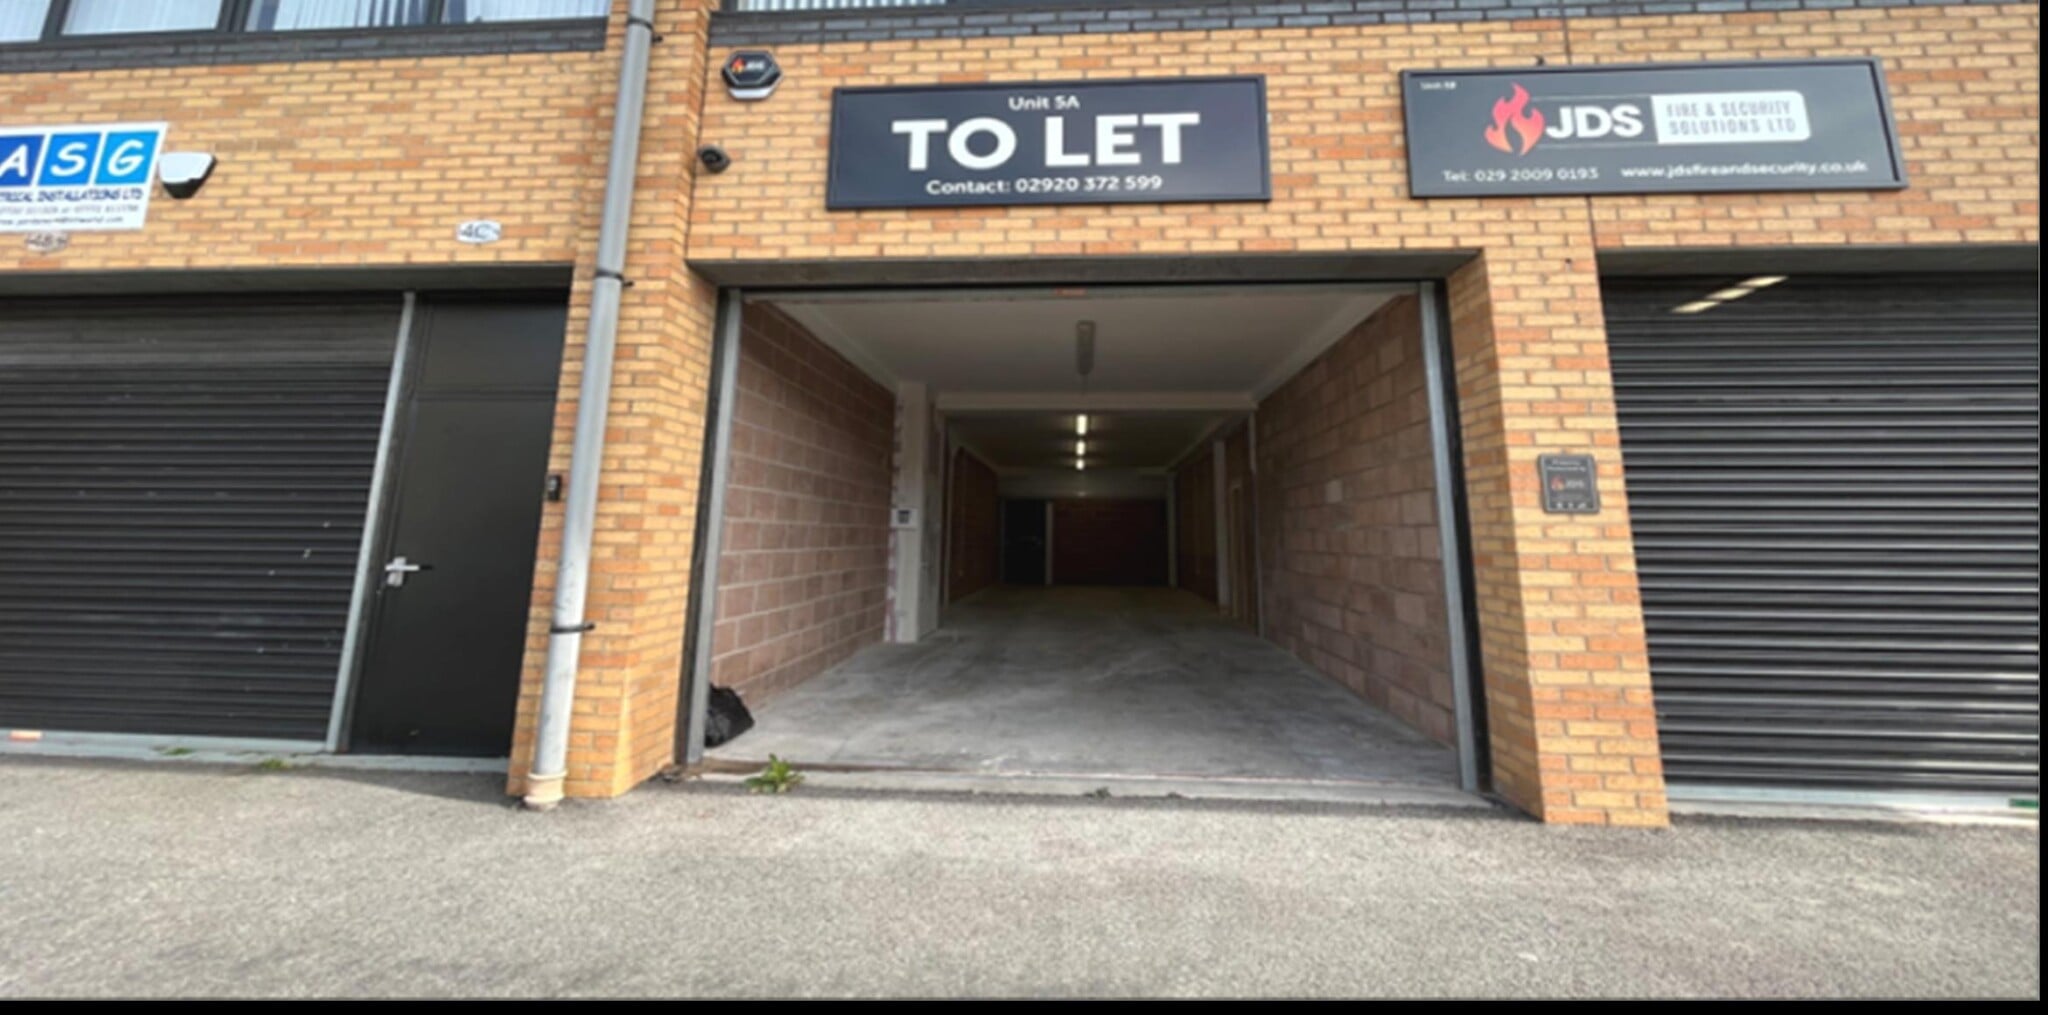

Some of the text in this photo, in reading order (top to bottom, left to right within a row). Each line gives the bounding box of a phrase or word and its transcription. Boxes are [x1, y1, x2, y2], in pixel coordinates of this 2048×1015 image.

[1008, 95, 1080, 110] Unit 5A
[1666, 99, 1791, 117] FIRE & SECURITY
[1544, 103, 1645, 140] JDS
[1669, 117, 1797, 135] SOLUTIONS LTD
[892, 113, 1201, 171] TO LET
[1474, 169, 1507, 182] 029
[1510, 168, 1553, 181] 2009
[1556, 166, 1599, 180] 0193
[926, 175, 1162, 196] Contact: 02920 372 599
